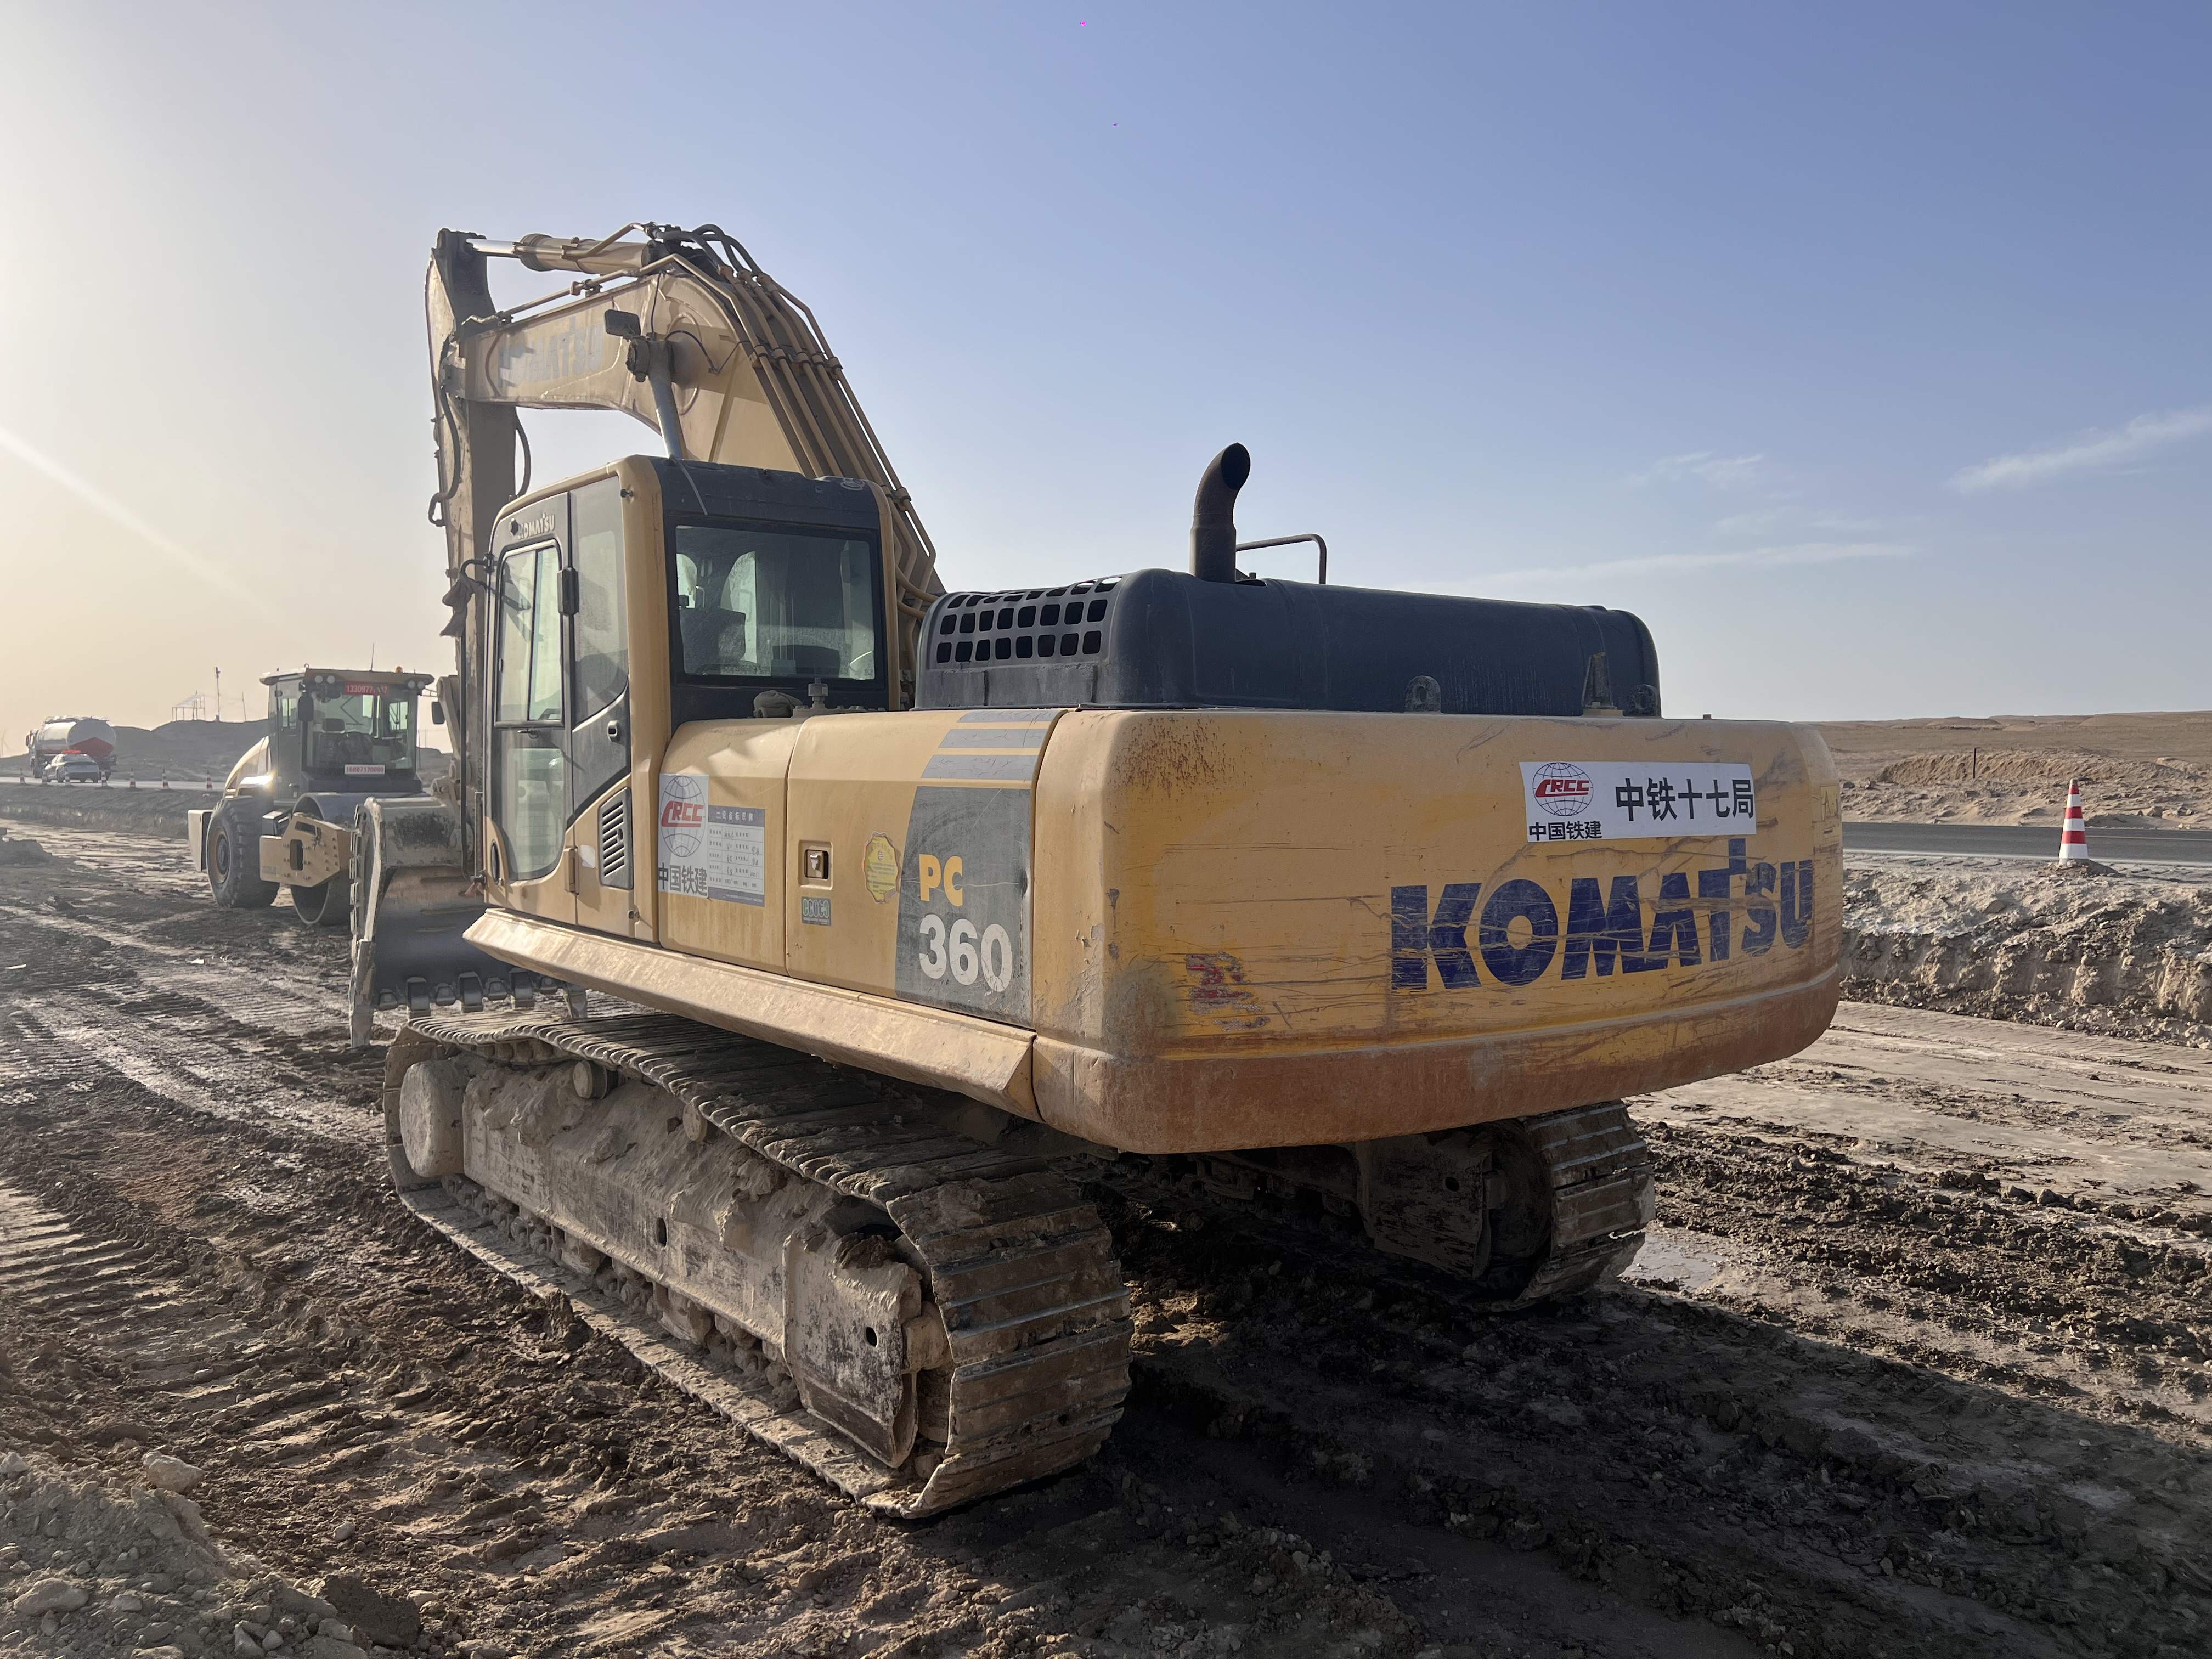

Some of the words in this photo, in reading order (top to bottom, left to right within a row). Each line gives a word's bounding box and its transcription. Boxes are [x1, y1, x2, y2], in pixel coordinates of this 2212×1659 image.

[498, 315, 604, 387] KMATSU
[1535, 779, 1590, 798] CRCC
[1615, 777, 1754, 821] 中铁十七局
[661, 800, 704, 827] CRCC
[1528, 821, 1602, 841] 中国铁建
[658, 862, 708, 896] 中国铁建
[919, 854, 963, 907] PC
[1391, 838, 1814, 992] KOMATSU
[919, 913, 1013, 992] 360
